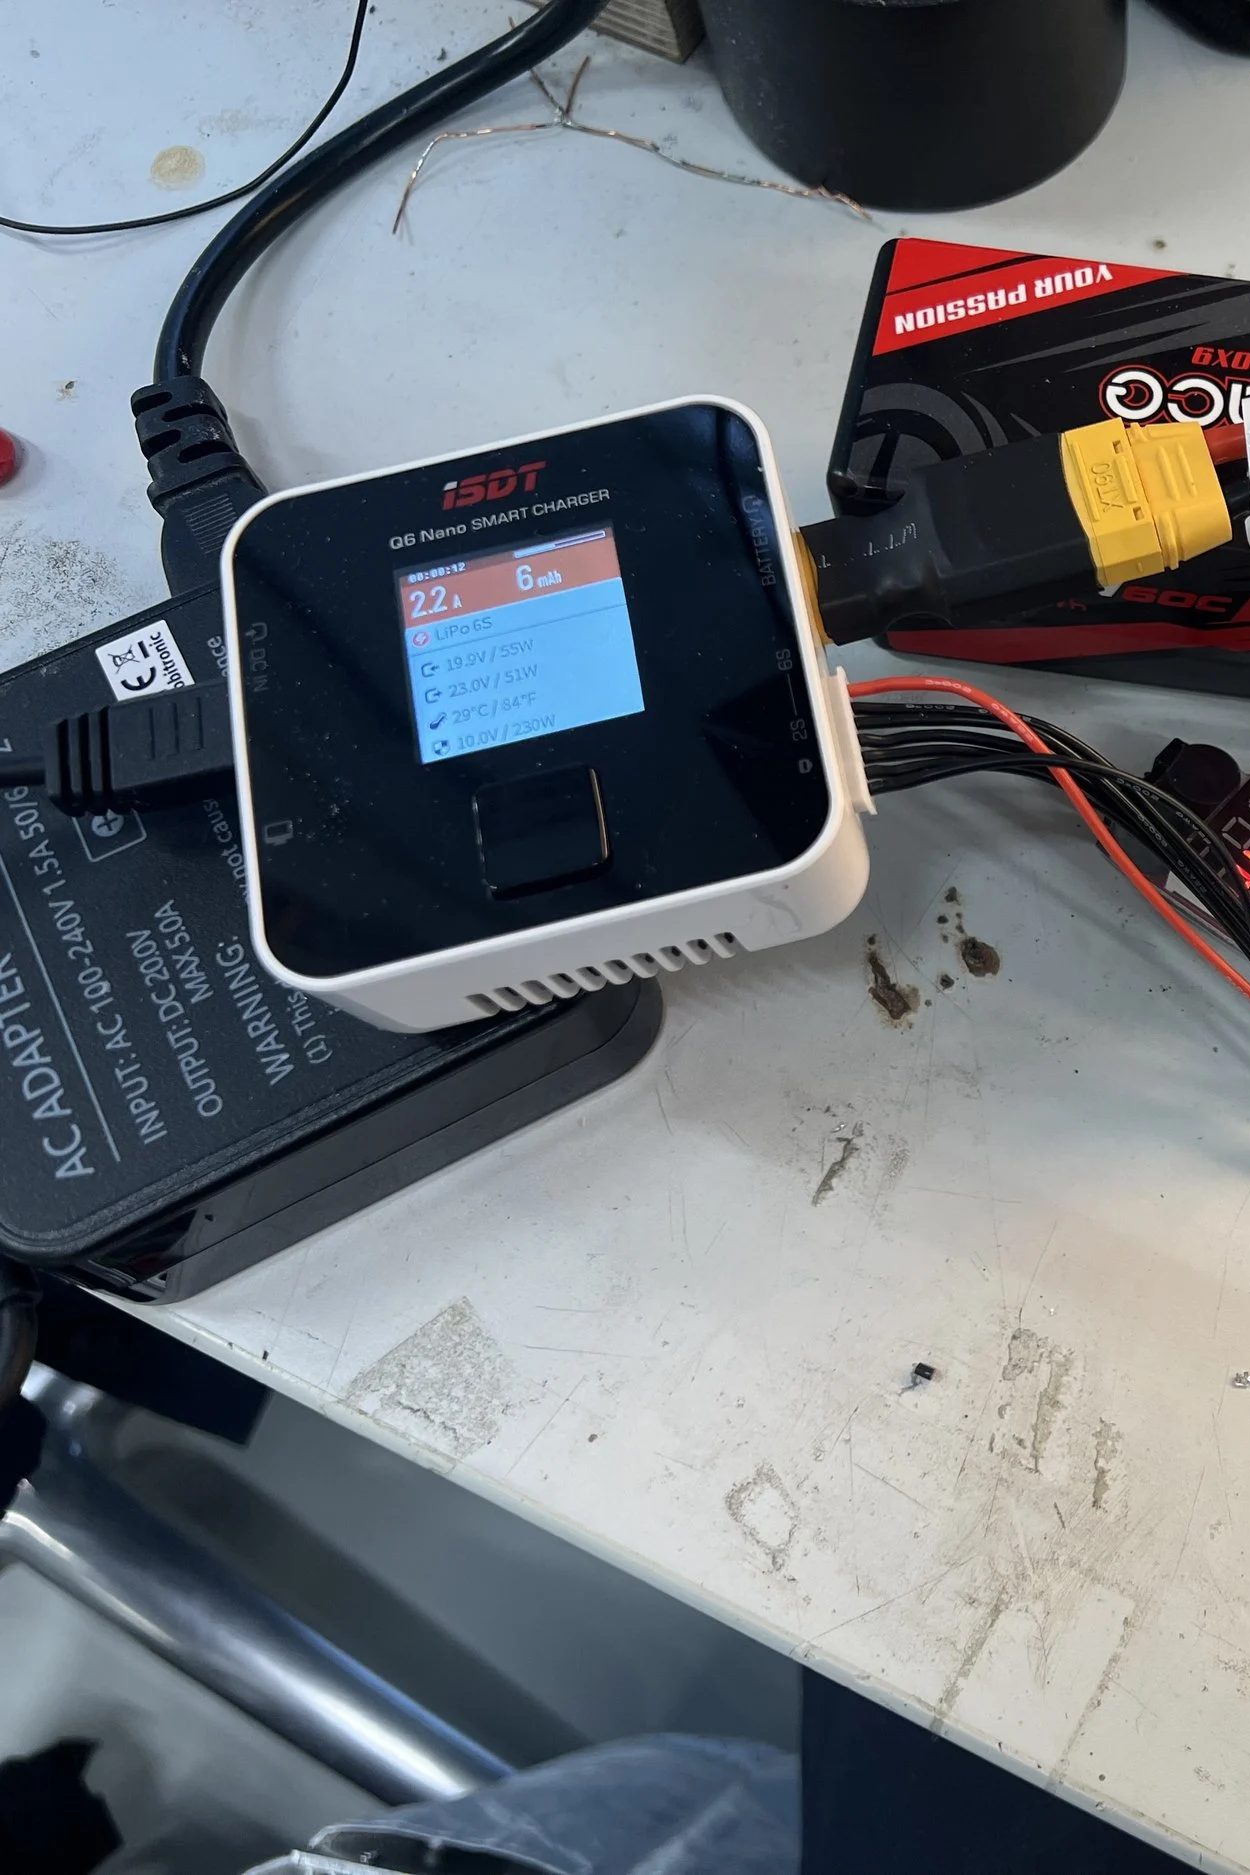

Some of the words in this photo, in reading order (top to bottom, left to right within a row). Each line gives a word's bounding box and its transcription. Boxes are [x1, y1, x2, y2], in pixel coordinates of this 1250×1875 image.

[1034, 264, 1114, 299] YOUR
[895, 284, 1028, 335] PASSION
[1091, 462, 1125, 513] XT90
[389, 533, 416, 550] Q6
[420, 522, 467, 545] Nano
[471, 506, 528, 531] SMART
[533, 488, 611, 517] CHARGER
[407, 561, 467, 584] 00:00:12
[749, 517, 777, 587] BATTERY
[515, 564, 534, 591] 6
[537, 570, 563, 589] mAh
[1122, 586, 1232, 613] 60C
[409, 585, 449, 619] 2.2
[452, 594, 463, 610] A
[435, 622, 470, 642] LiPo
[473, 616, 493, 633] 6S
[150, 631, 186, 690] obitronic
[251, 647, 268, 672] DC
[446, 650, 487, 672] 19.9V
[500, 639, 535, 659] 55W
[448, 676, 490, 698] 23.0V
[504, 664, 539, 684] 51W
[452, 703, 490, 724] 29°C
[457, 729, 499, 751] 10.0V
[511, 713, 556, 737] 230W
[29, 839, 67, 895] 1.5A
[154, 899, 192, 949] 5.0A
[48, 899, 114, 1014] 100-240V
[126, 929, 170, 987] 20.0V
[172, 946, 214, 1004] MAX
[151, 983, 185, 1022] DC
[215, 935, 294, 1087] WARNING:
[287, 990, 316, 1037] This
[96, 1013, 132, 1050] AC
[303, 1033, 333, 1064] (1)
[166, 1018, 224, 1117] OUTPUT:
[114, 1052, 168, 1145] INPUT:
[42, 1123, 95, 1179] AC
